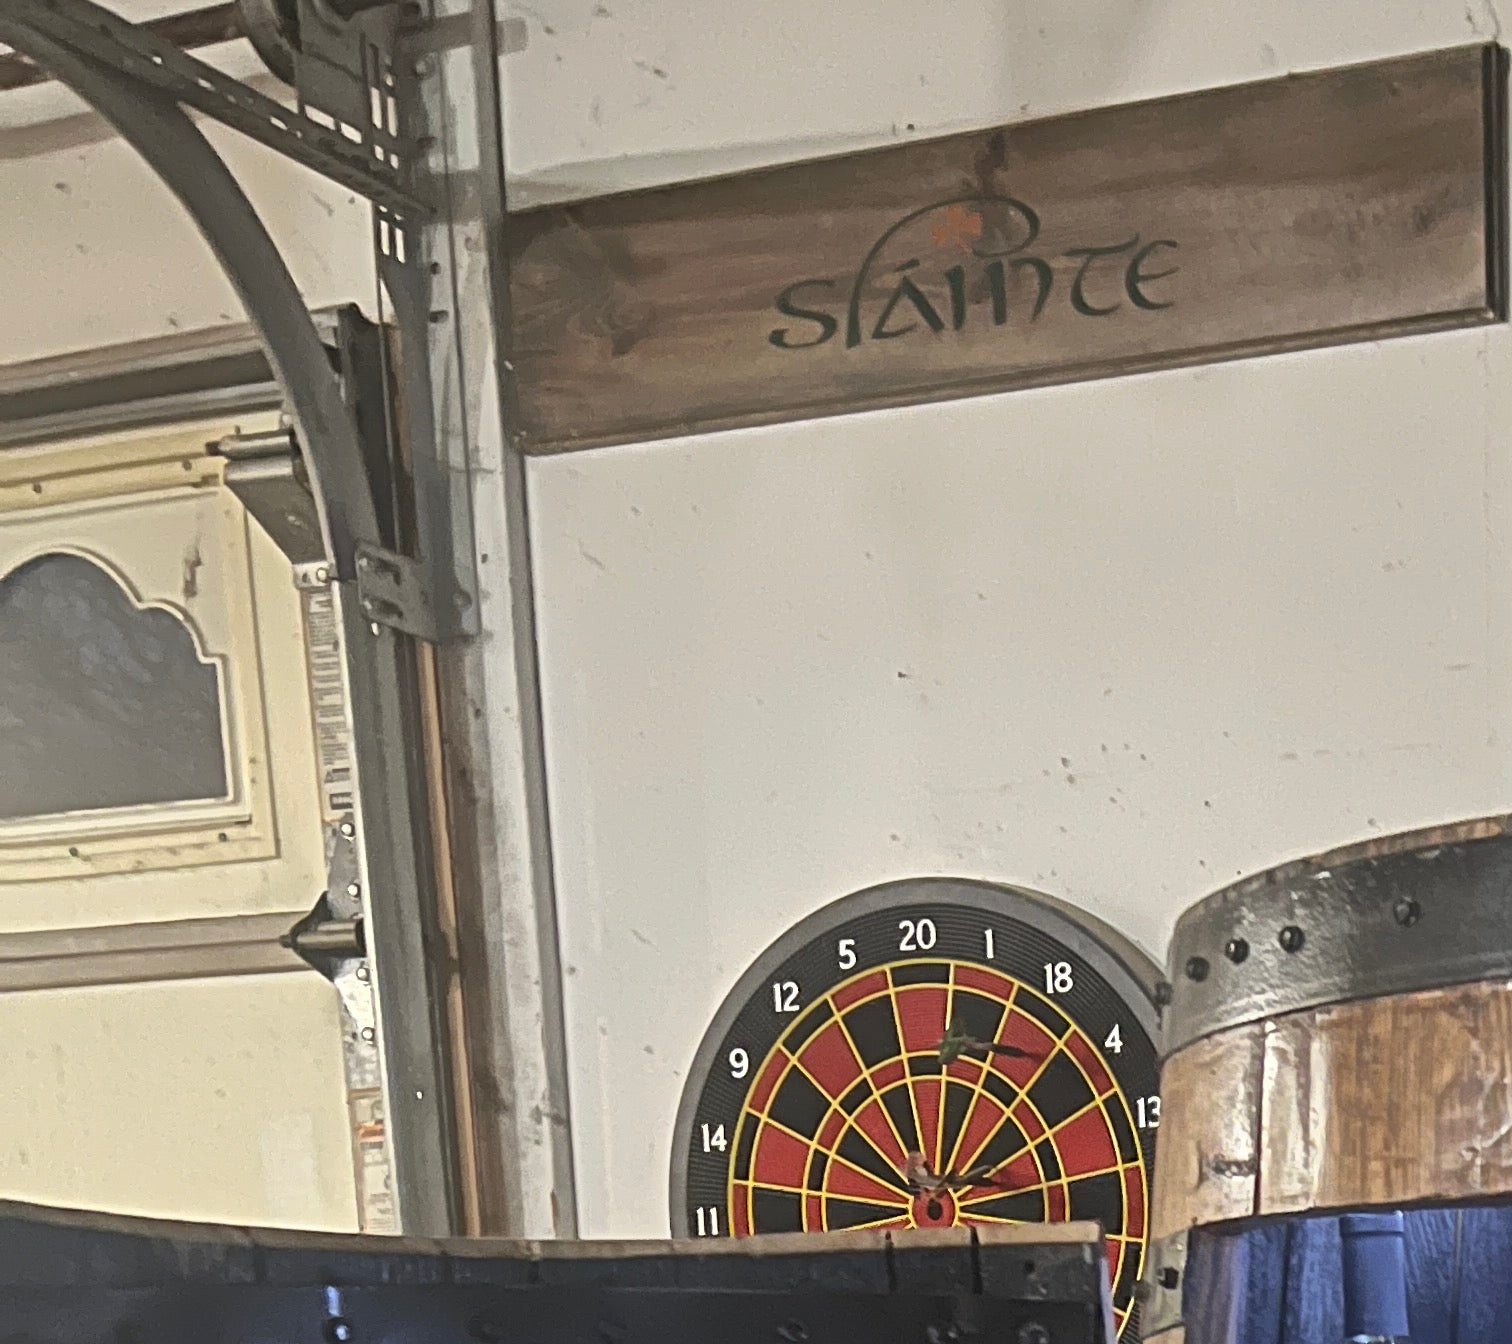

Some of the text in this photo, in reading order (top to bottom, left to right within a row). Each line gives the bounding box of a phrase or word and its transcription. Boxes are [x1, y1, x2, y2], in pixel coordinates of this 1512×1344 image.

[898, 918, 938, 951] 20
[985, 929, 996, 959] 1
[838, 939, 858, 970] 5
[1043, 961, 1075, 995] 18
[772, 981, 801, 1014] 12
[1104, 1024, 1125, 1054] 4
[728, 1048, 750, 1079] 9
[1136, 1096, 1162, 1129] 13
[700, 1123, 728, 1154] 14
[696, 1207, 720, 1237] 11
